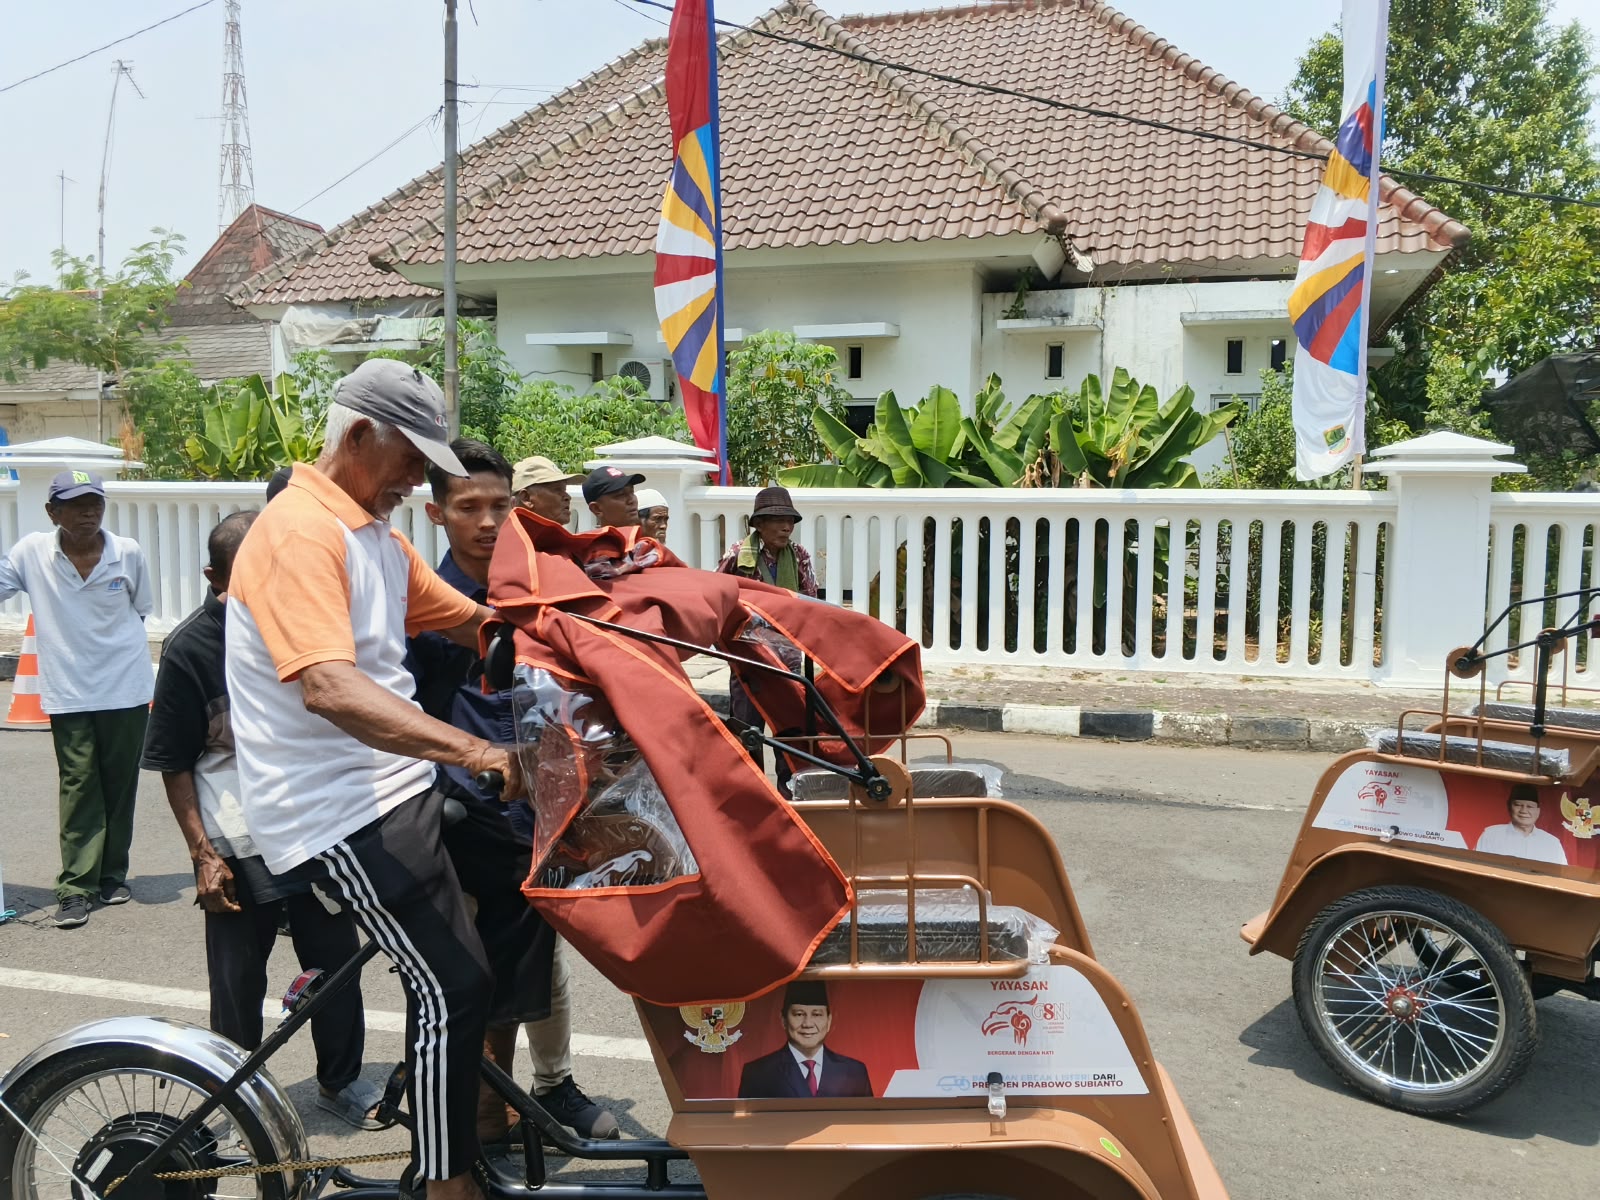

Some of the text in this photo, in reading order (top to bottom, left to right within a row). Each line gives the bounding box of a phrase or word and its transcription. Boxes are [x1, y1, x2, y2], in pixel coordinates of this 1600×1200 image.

[1365, 769, 1399, 778] YAYASAN
[1415, 833, 1444, 841] SUBIANTO
[990, 981, 1048, 991] YAYASAN
[1093, 1073, 1116, 1081] DARI
[972, 1081, 1019, 1089] PREDEN
[1074, 1080, 1123, 1088] SUBIANTO
